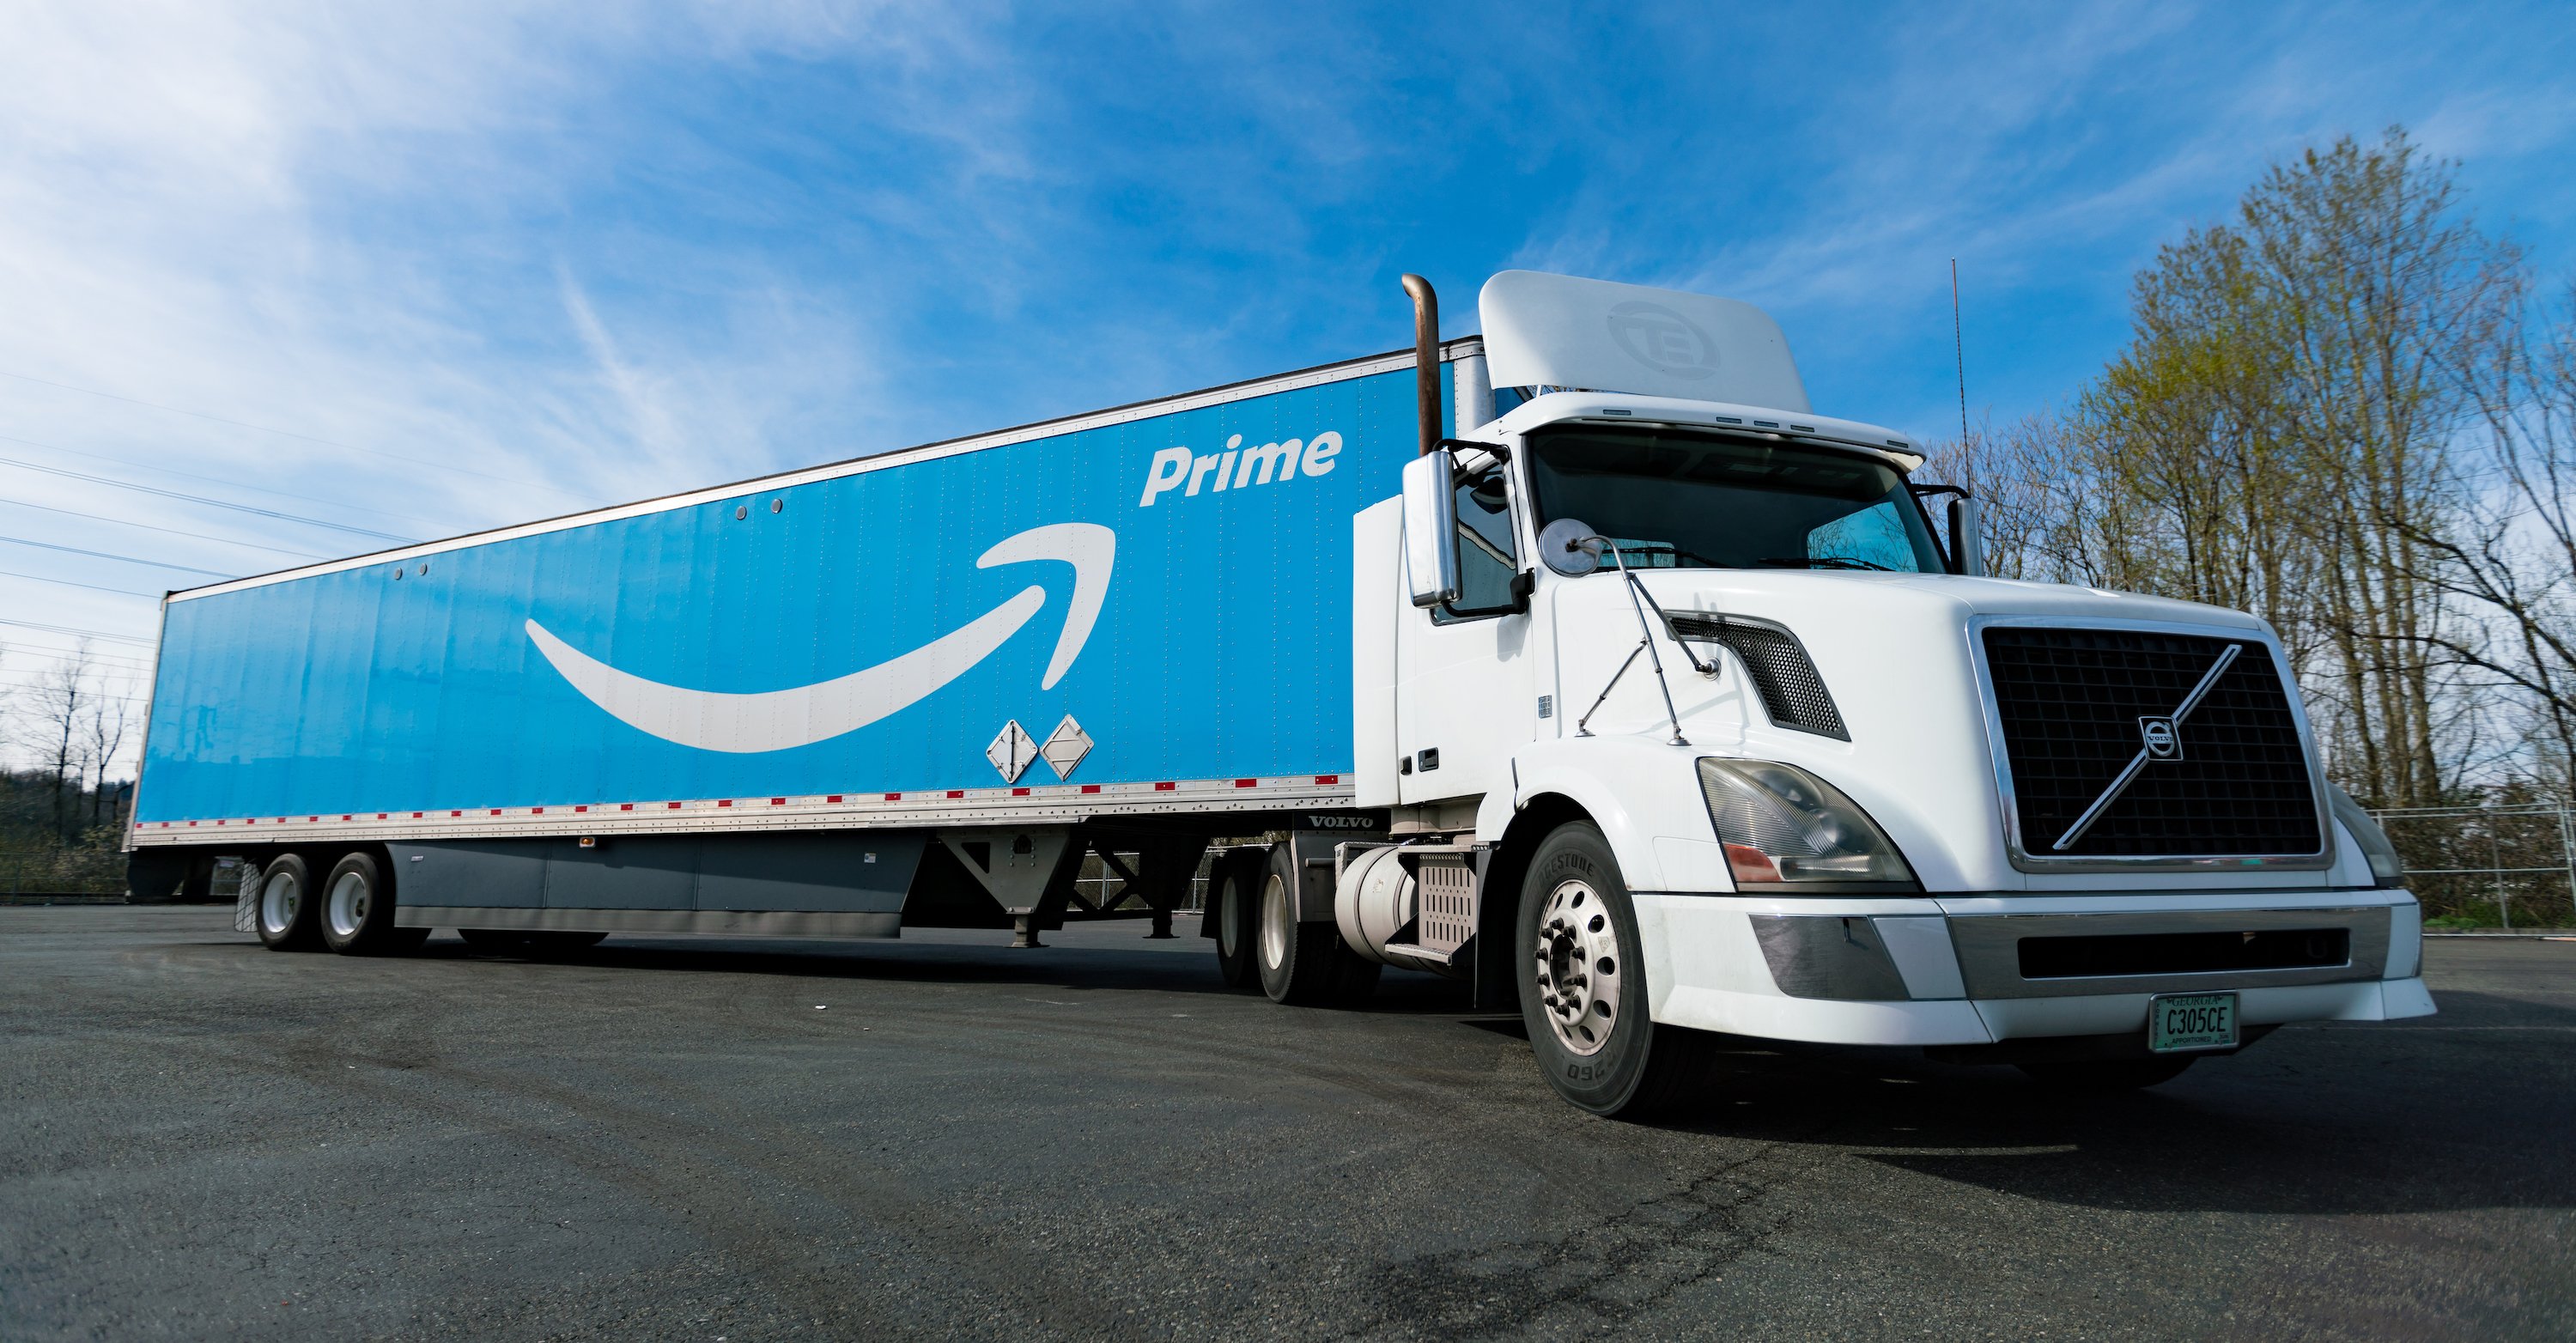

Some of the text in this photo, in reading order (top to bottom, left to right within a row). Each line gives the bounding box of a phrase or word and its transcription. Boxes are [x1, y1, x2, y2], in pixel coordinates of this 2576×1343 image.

[1139, 430, 1343, 507] Prime
[1308, 815, 1374, 828] VOLVO
[2172, 995, 2218, 1006] GEORGIA
[2167, 1006, 2228, 1035] C305CE
